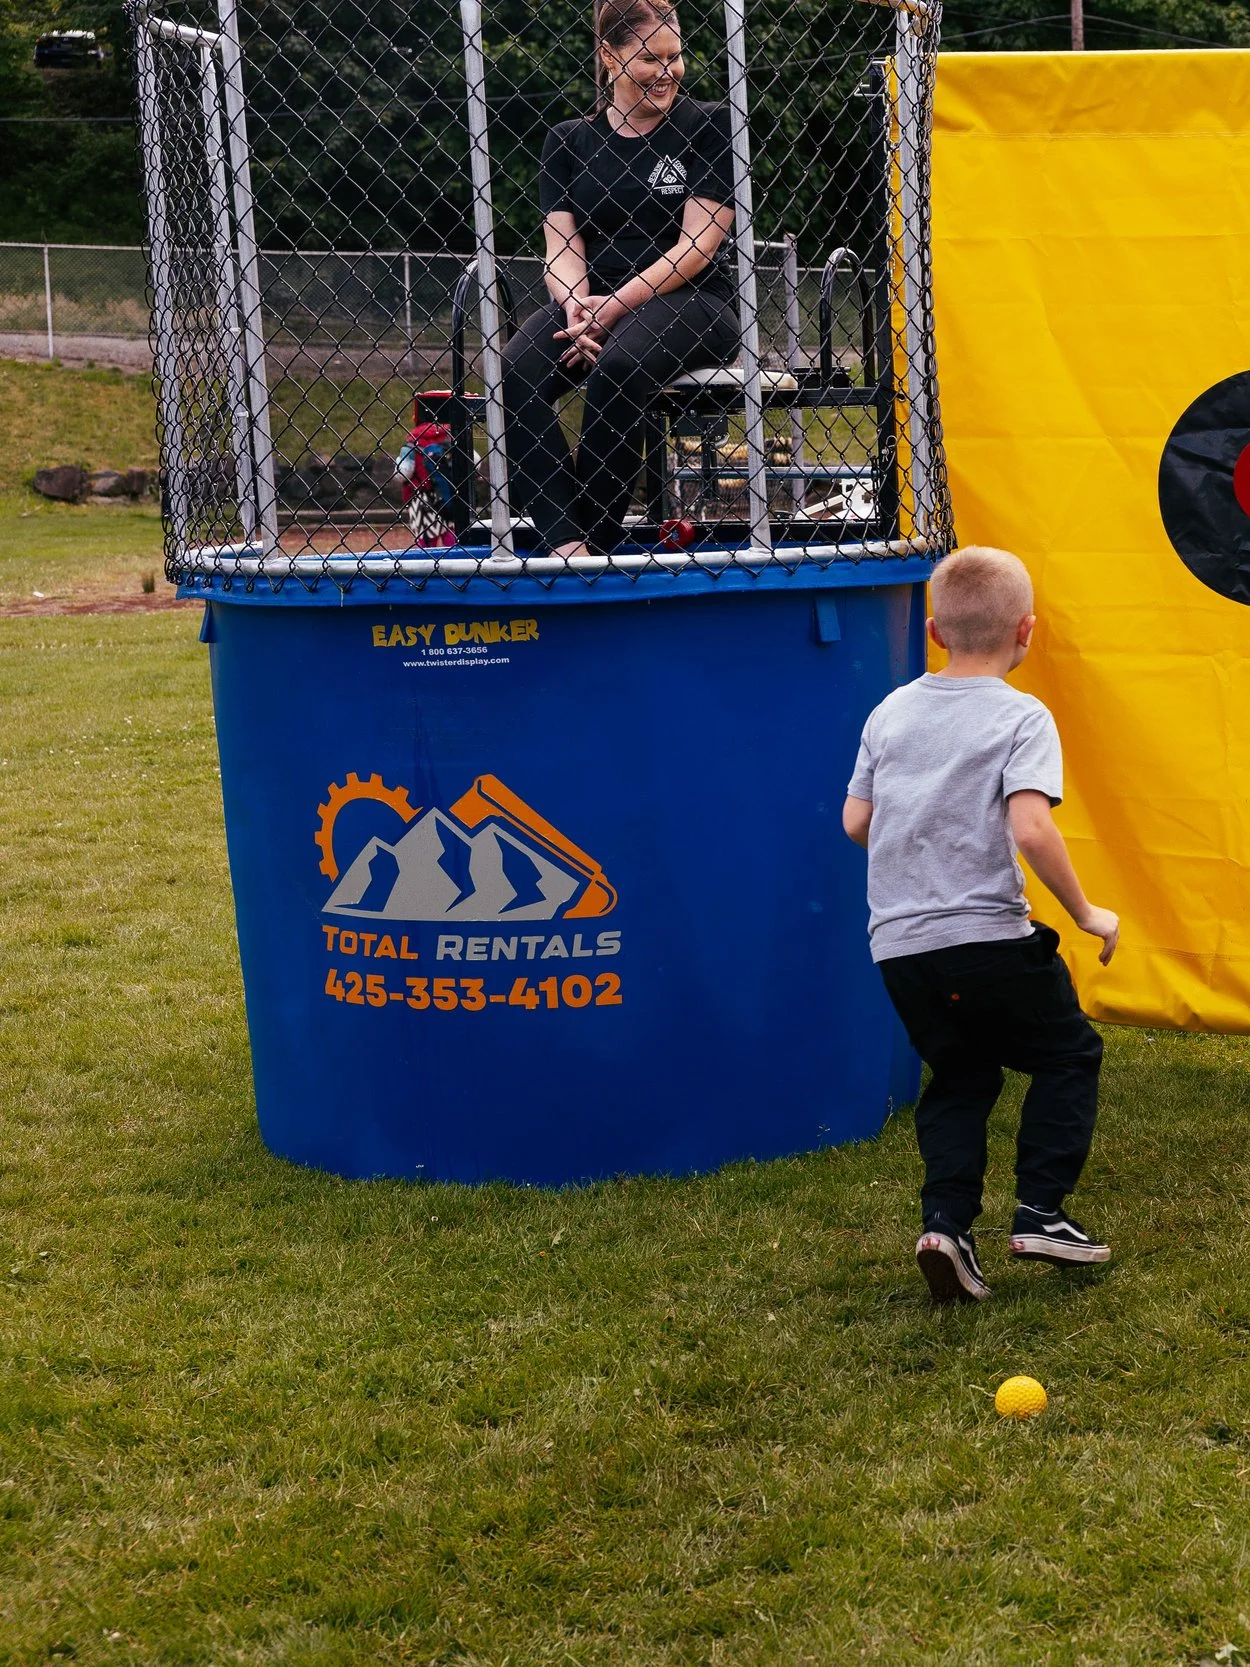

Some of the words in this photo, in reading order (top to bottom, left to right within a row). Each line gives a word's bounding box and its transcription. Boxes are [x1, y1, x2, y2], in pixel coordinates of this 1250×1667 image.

[372, 624, 436, 647] EASY
[444, 619, 540, 645] DUNKER
[402, 656, 510, 668] www.twisterdisplay.com
[428, 648, 445, 656] 800
[446, 646, 488, 655] 637-3656
[322, 925, 419, 960] TOTAL
[436, 931, 622, 961] RENTALS
[325, 968, 623, 1012] 425-353-4102
